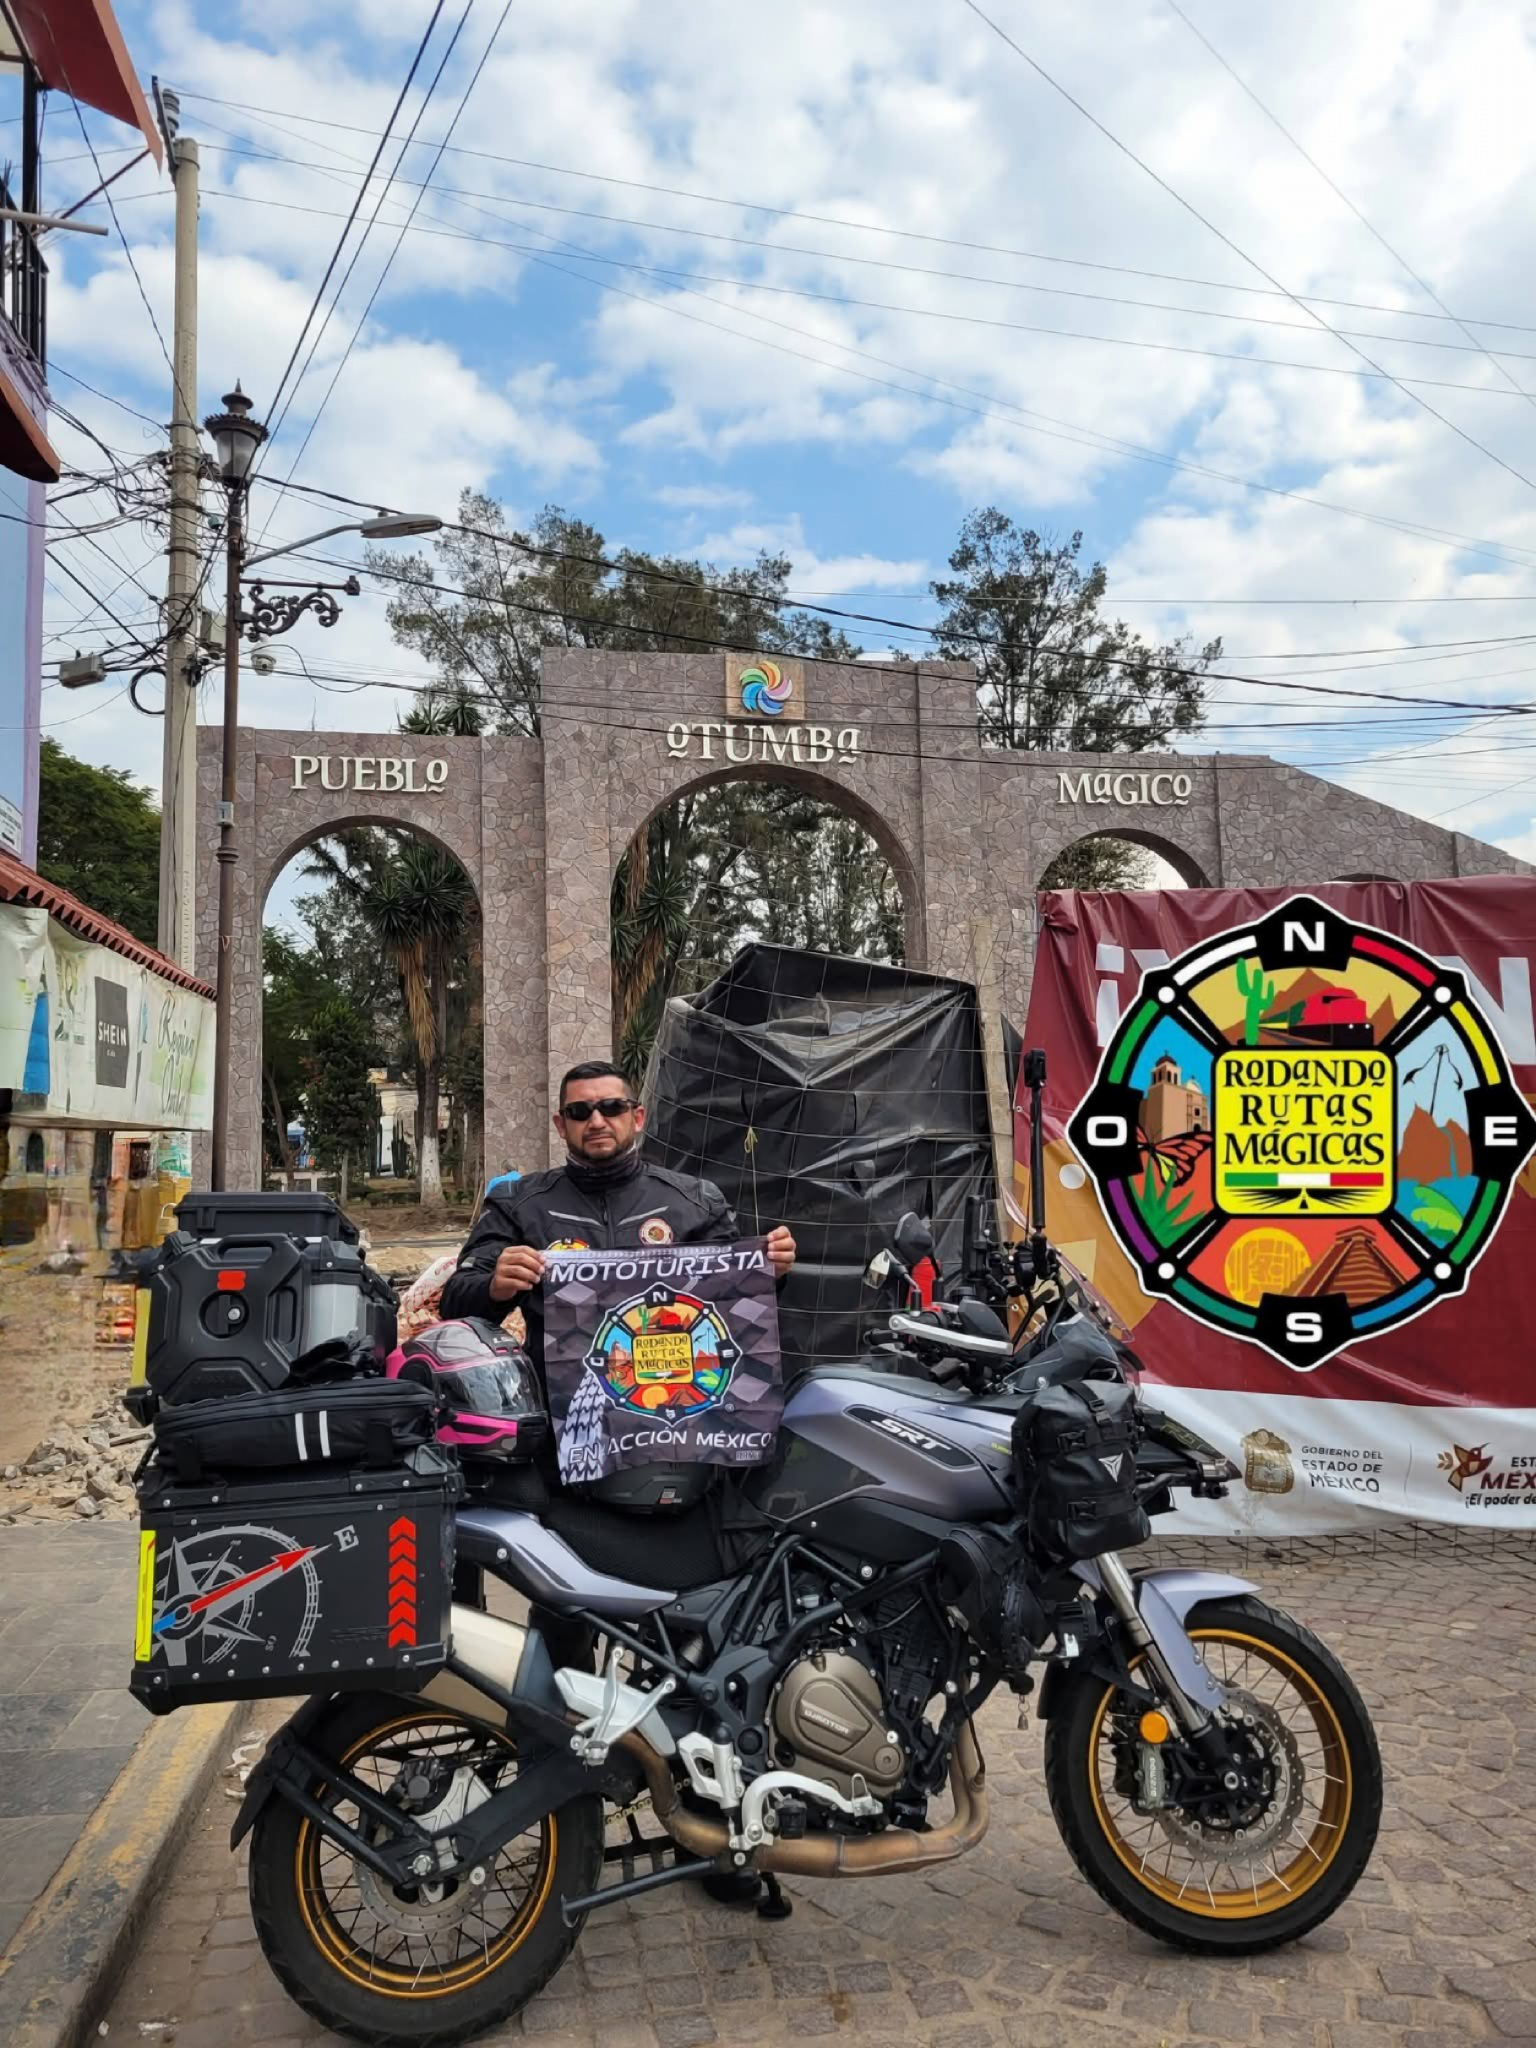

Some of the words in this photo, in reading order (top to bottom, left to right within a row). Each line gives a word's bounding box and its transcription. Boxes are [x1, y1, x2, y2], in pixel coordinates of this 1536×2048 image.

[667, 723, 861, 763] OTUMBA
[291, 755, 449, 793] PUEBLO
[98, 1021, 127, 1047] SHEIN
[550, 1250, 765, 1283] MOTOTURISTA
[652, 1291, 668, 1302] N
[636, 1335, 688, 1349] RODANDO
[641, 1348, 685, 1358] RUTAS
[568, 1441, 599, 1464] EN
[607, 1426, 688, 1456] ACCIÓN
[696, 1430, 773, 1449] MÉXICO
[870, 1418, 953, 1451] SRT
[1301, 1446, 1360, 1458] GOBIERNO
[1362, 1450, 1384, 1460] DEL
[1301, 1460, 1358, 1472] ESTADO
[1362, 1463, 1383, 1474] DE
[1309, 1472, 1380, 1493] MÉXICO
[1484, 1493, 1521, 1509] poder
[333, 1525, 359, 1552] E
